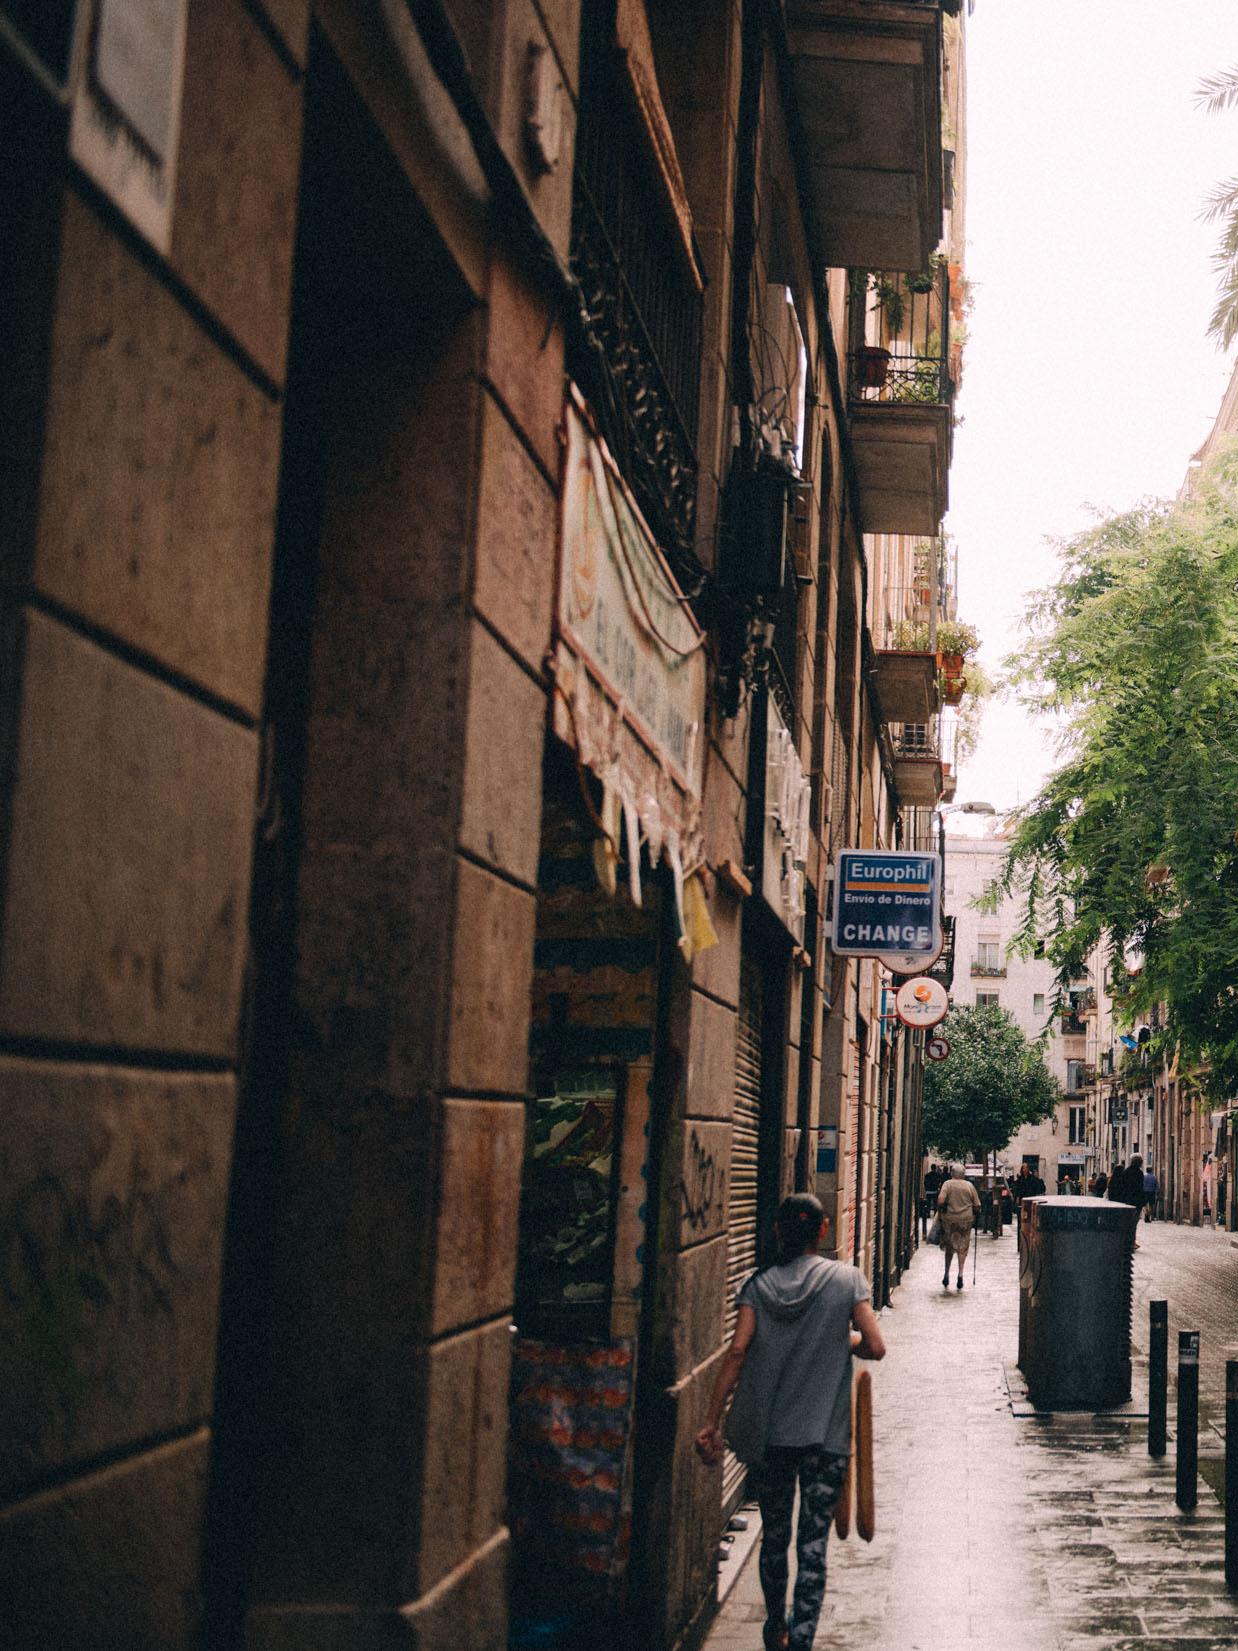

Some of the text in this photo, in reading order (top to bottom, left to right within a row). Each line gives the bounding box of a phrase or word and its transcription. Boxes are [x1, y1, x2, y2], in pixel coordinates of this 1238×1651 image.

[852, 863, 927, 882] Europhil
[878, 894, 891, 904] de
[895, 895, 931, 906] Dinero
[844, 924, 929, 942] CHANGE
